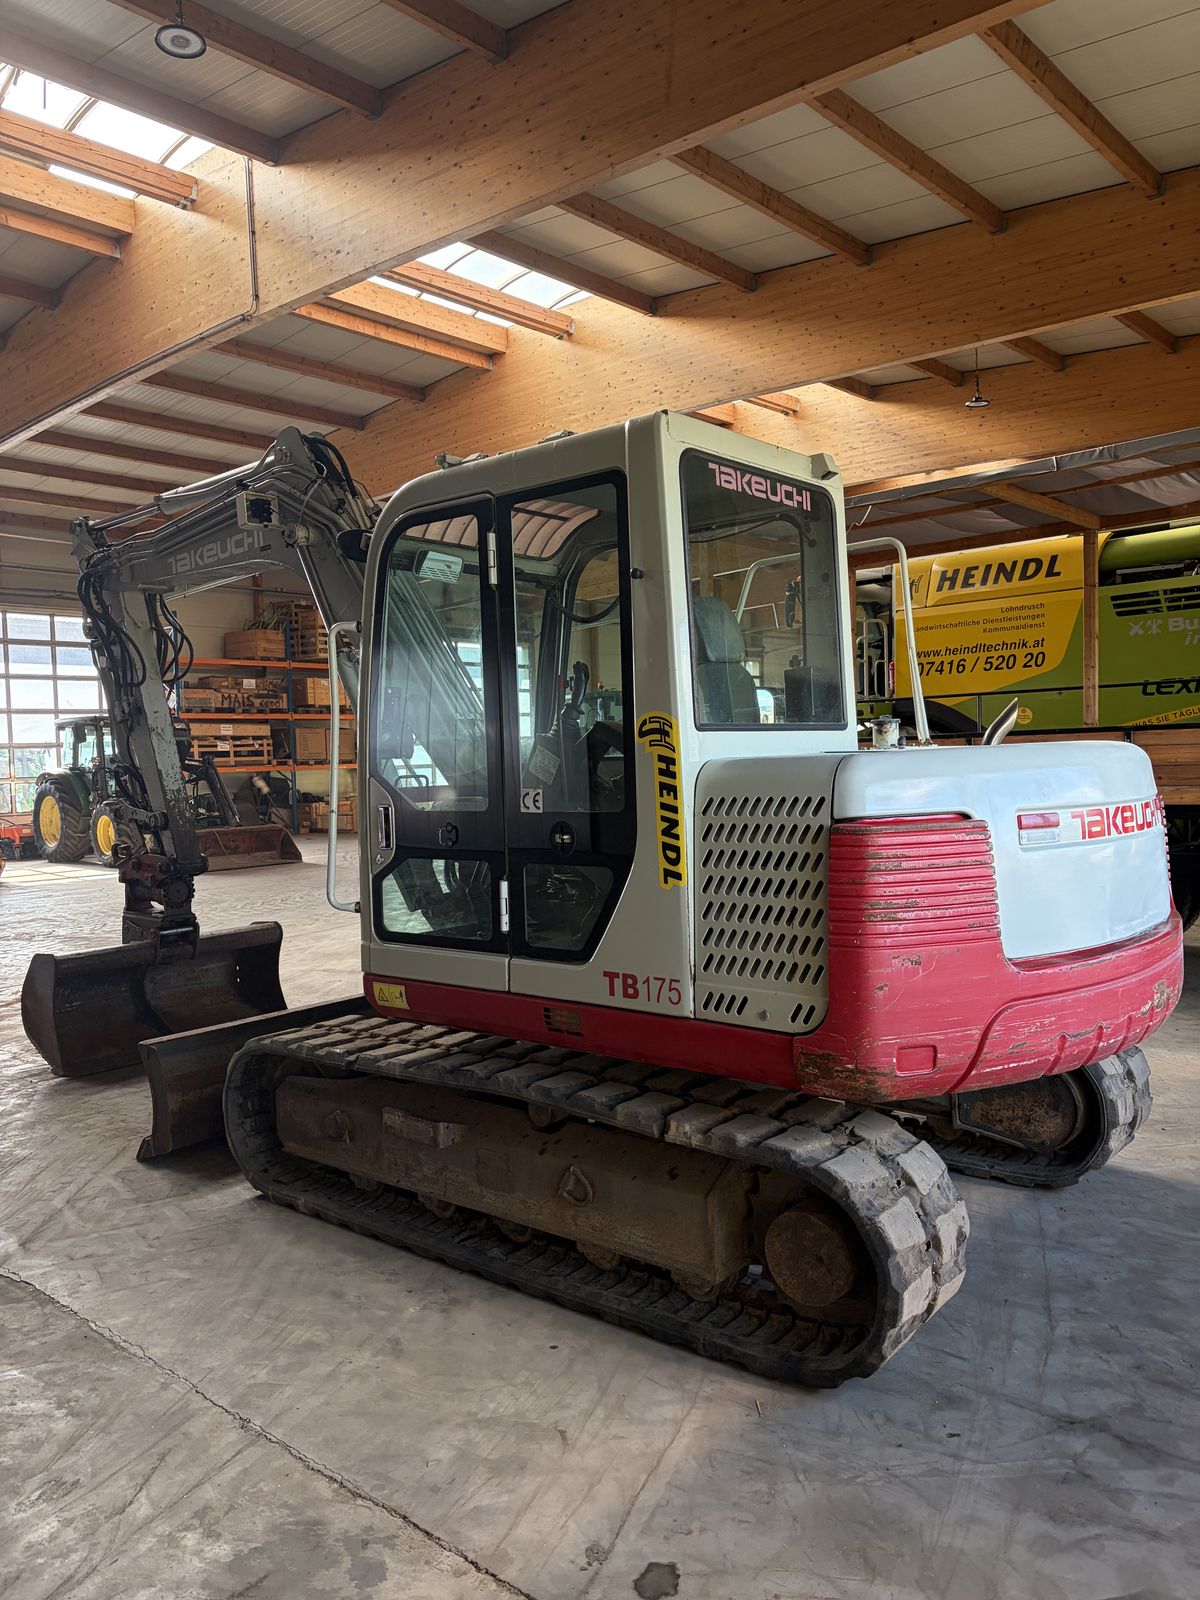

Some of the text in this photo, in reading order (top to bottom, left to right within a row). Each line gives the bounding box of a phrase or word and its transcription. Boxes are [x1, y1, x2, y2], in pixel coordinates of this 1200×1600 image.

[708, 462, 811, 512] TAKEUCHI
[936, 554, 1062, 593] HEINDL
[1000, 602, 1045, 614] Lohndrusch
[914, 612, 1046, 633] andwirtschaftliche Dienstleistungen
[982, 621, 1046, 634] Kommunaldienst
[983, 653, 1017, 672] 520
[1022, 651, 1046, 669] 20
[221, 693, 255, 708] MAIS
[1155, 714, 1171, 724] SIE
[522, 791, 541, 810] CE
[657, 753, 683, 885] HEINDL
